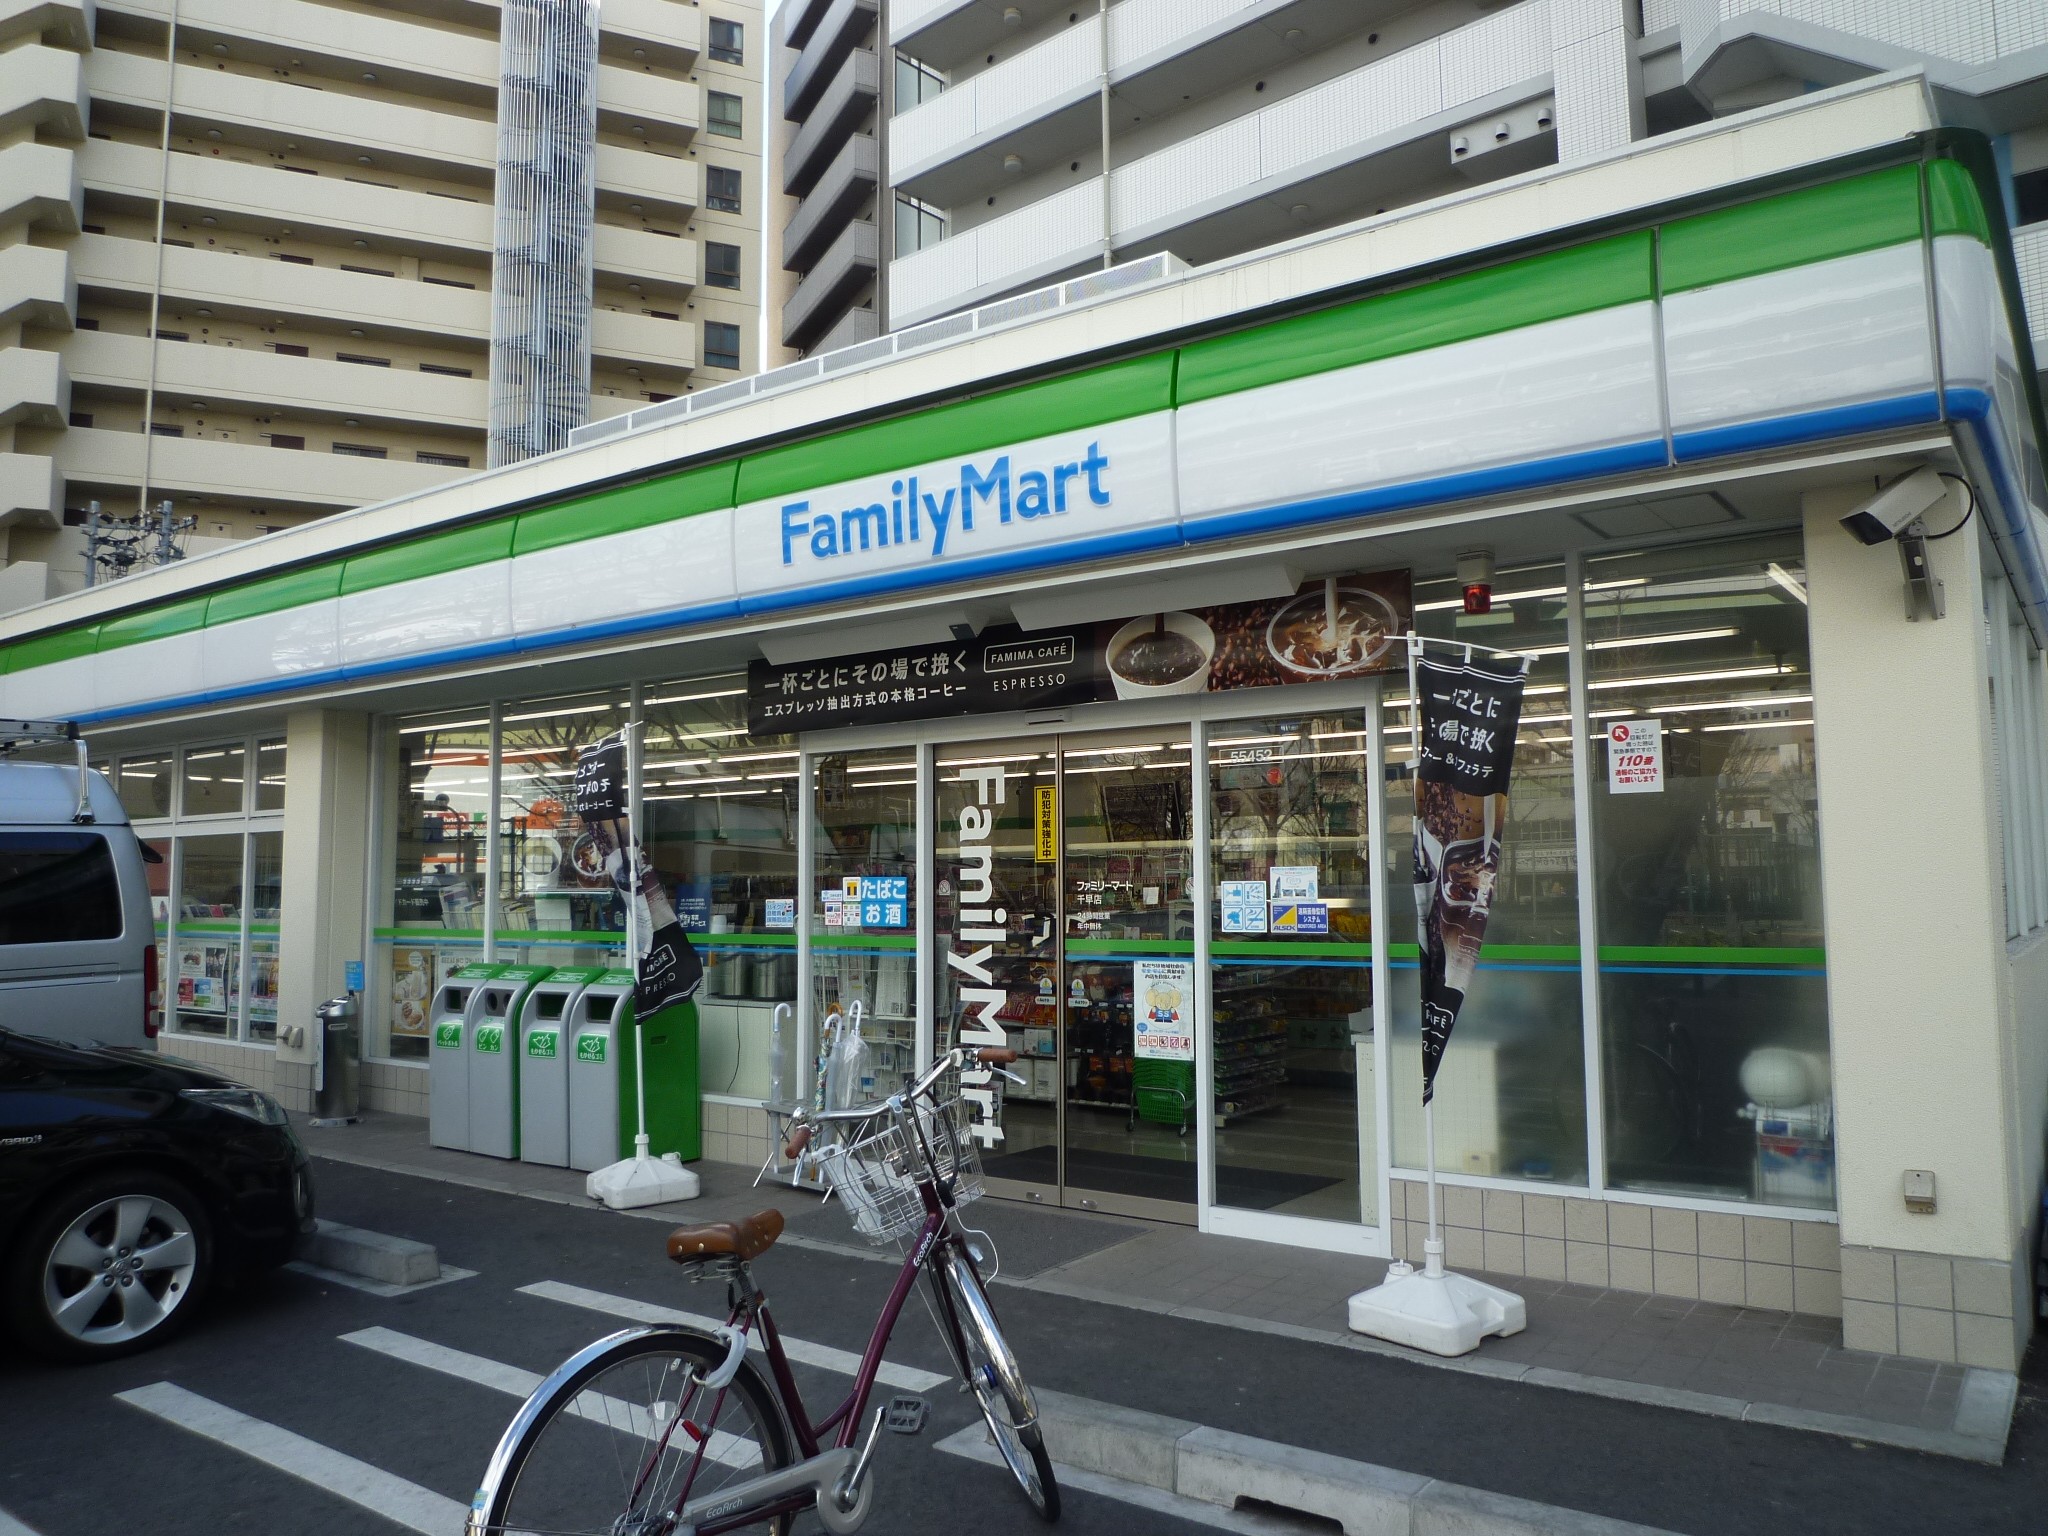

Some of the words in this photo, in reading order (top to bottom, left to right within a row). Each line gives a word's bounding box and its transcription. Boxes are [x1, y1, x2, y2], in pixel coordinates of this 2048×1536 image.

[781, 440, 1113, 567] FamilyMart
[991, 649, 1034, 664] FAMIMA
[1038, 642, 1067, 658] CAFÉ
[764, 650, 967, 695] 一杯ごとにその場で挽く
[993, 673, 1066, 692] ESPRESSO
[764, 683, 967, 717] エスプレッソ抽出方式の本格コーヒー
[1231, 748, 1273, 763] 55452
[1618, 754, 1655, 767] 110番
[1041, 789, 1052, 859] 防犯対策強化中
[861, 879, 906, 899] たばこ
[1076, 880, 1134, 891] ファミリーマート
[1076, 894, 1103, 905] 千早店
[866, 903, 902, 925] お酒
[1077, 912, 1111, 920] 24時間営業
[1303, 915, 1321, 923] システム
[1077, 922, 1102, 930] 年中無休
[706, 1496, 743, 1518] EcoArch
